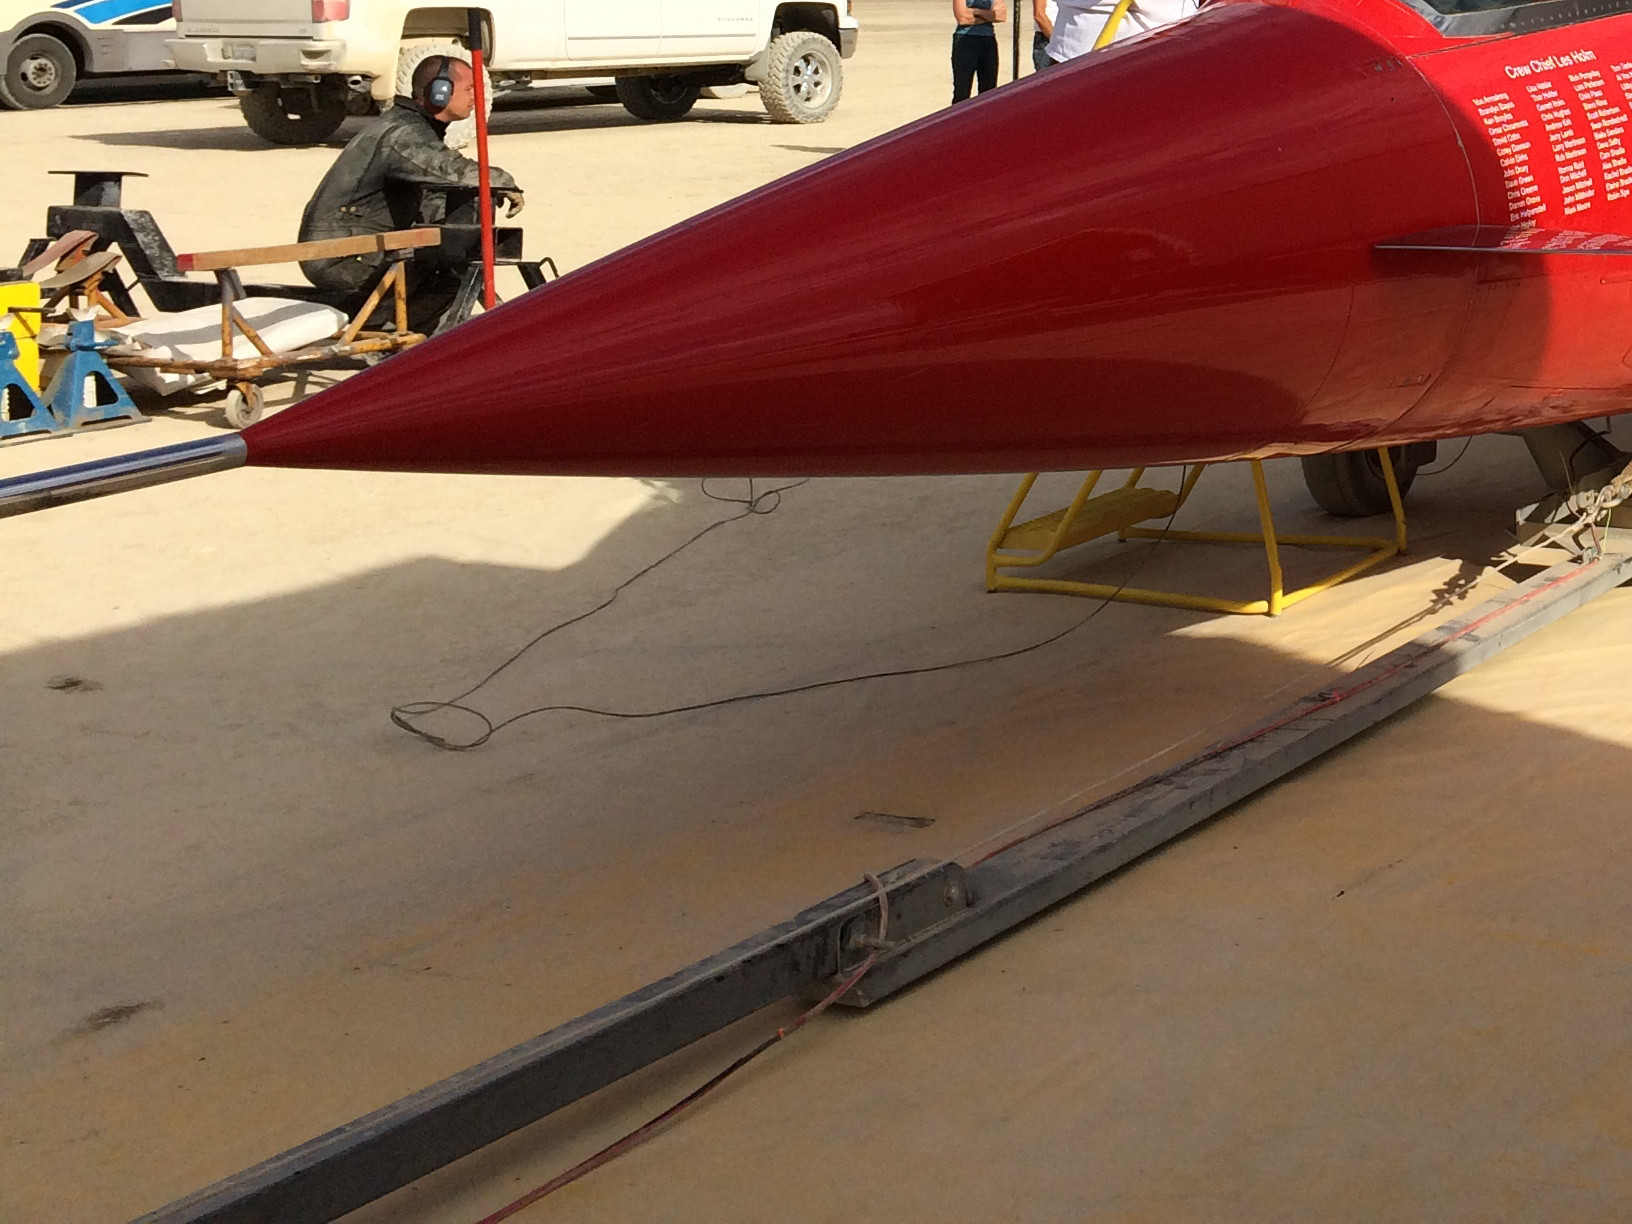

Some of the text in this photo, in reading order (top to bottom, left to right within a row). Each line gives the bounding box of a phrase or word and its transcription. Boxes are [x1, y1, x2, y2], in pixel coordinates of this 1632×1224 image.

[1504, 49, 1597, 79] Crew Chief Les Holm
